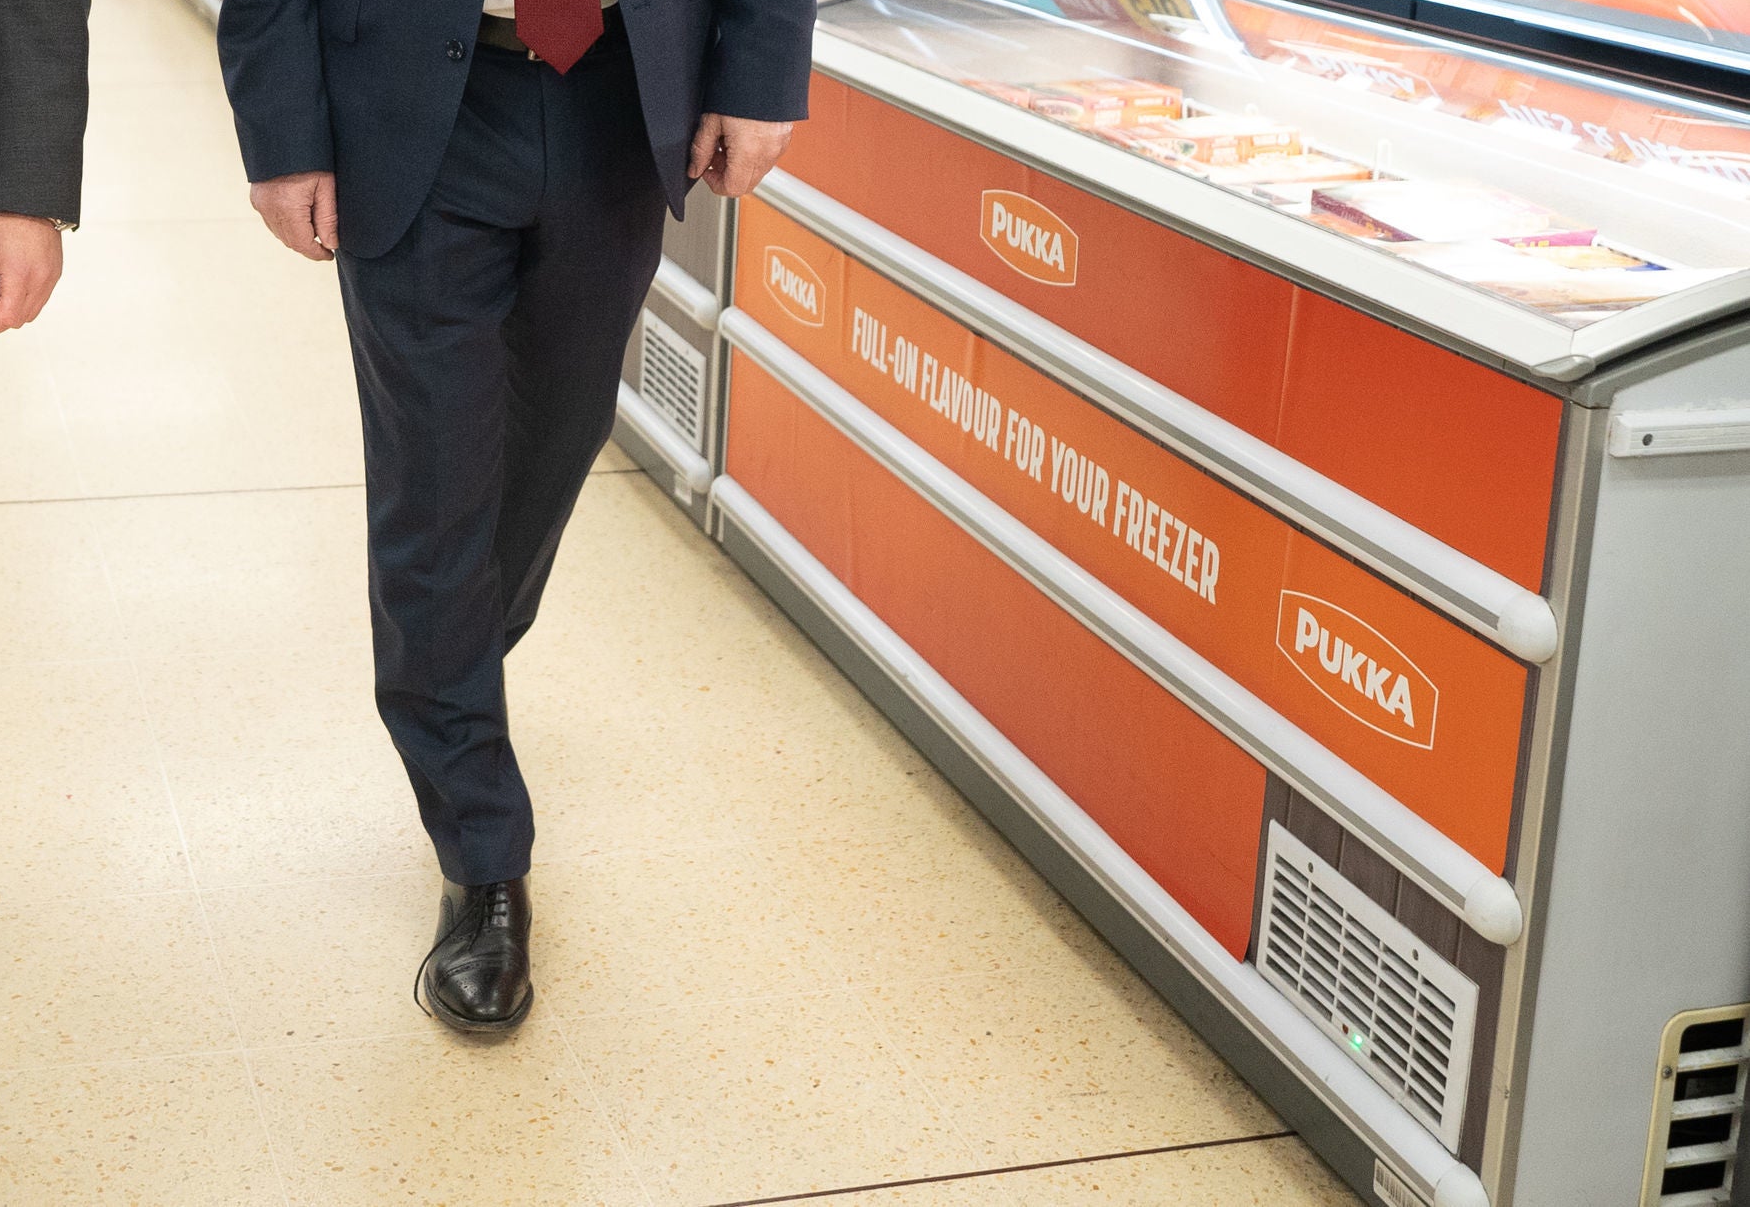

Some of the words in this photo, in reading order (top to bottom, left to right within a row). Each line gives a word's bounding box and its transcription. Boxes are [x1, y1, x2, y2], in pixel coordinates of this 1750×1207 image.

[770, 254, 817, 316] PUKKA
[990, 201, 1065, 273] PUKKA
[852, 306, 921, 395] FULL-ON
[921, 349, 1002, 453] FLAVOUR
[1004, 402, 1046, 484] FOR
[1051, 435, 1108, 530] YOUR
[1113, 480, 1222, 606] FREEZER
[1294, 606, 1415, 728] PUKKA
